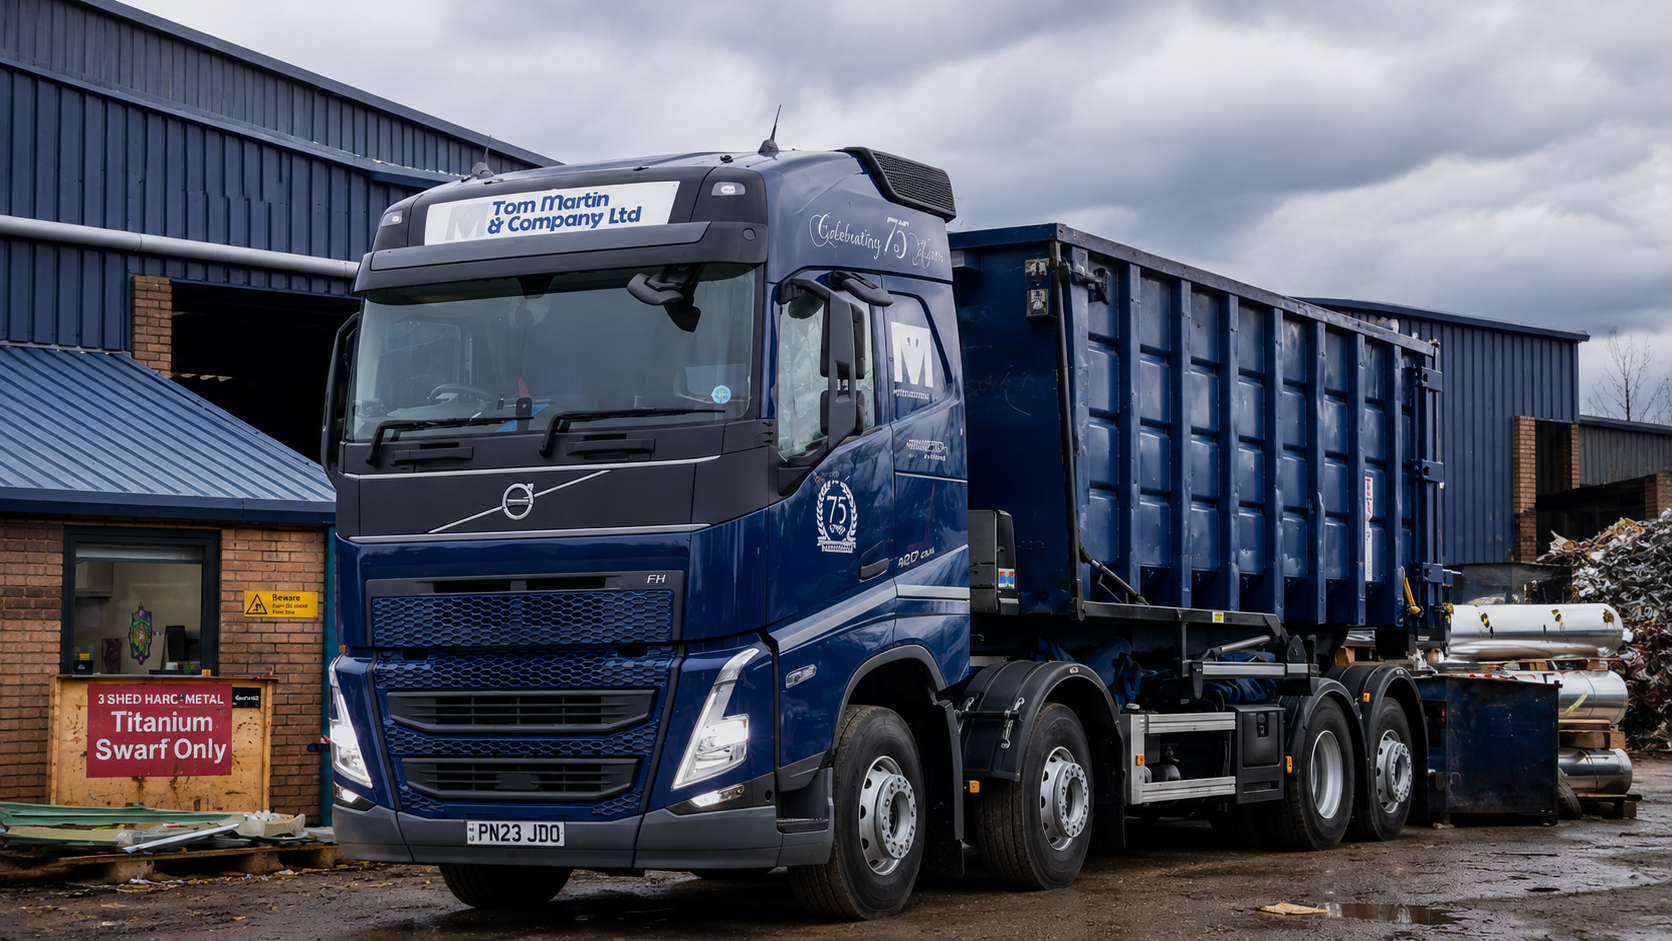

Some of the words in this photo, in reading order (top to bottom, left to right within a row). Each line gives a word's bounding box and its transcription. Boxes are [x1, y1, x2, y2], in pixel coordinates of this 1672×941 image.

[492, 199, 536, 216] Tom
[540, 191, 610, 212] Martin
[487, 217, 504, 234] &
[507, 211, 604, 233] Company
[608, 206, 643, 225] Ltd
[827, 495, 847, 525] 75
[646, 574, 666, 584] FH
[272, 593, 301, 601] Beware
[98, 693, 104, 705] 3
[107, 693, 142, 705] SHED
[111, 710, 213, 732] Titanium
[95, 738, 170, 760] Swarf
[174, 738, 227, 764] Only
[478, 823, 522, 842] PN23
[527, 823, 560, 842] JDO
